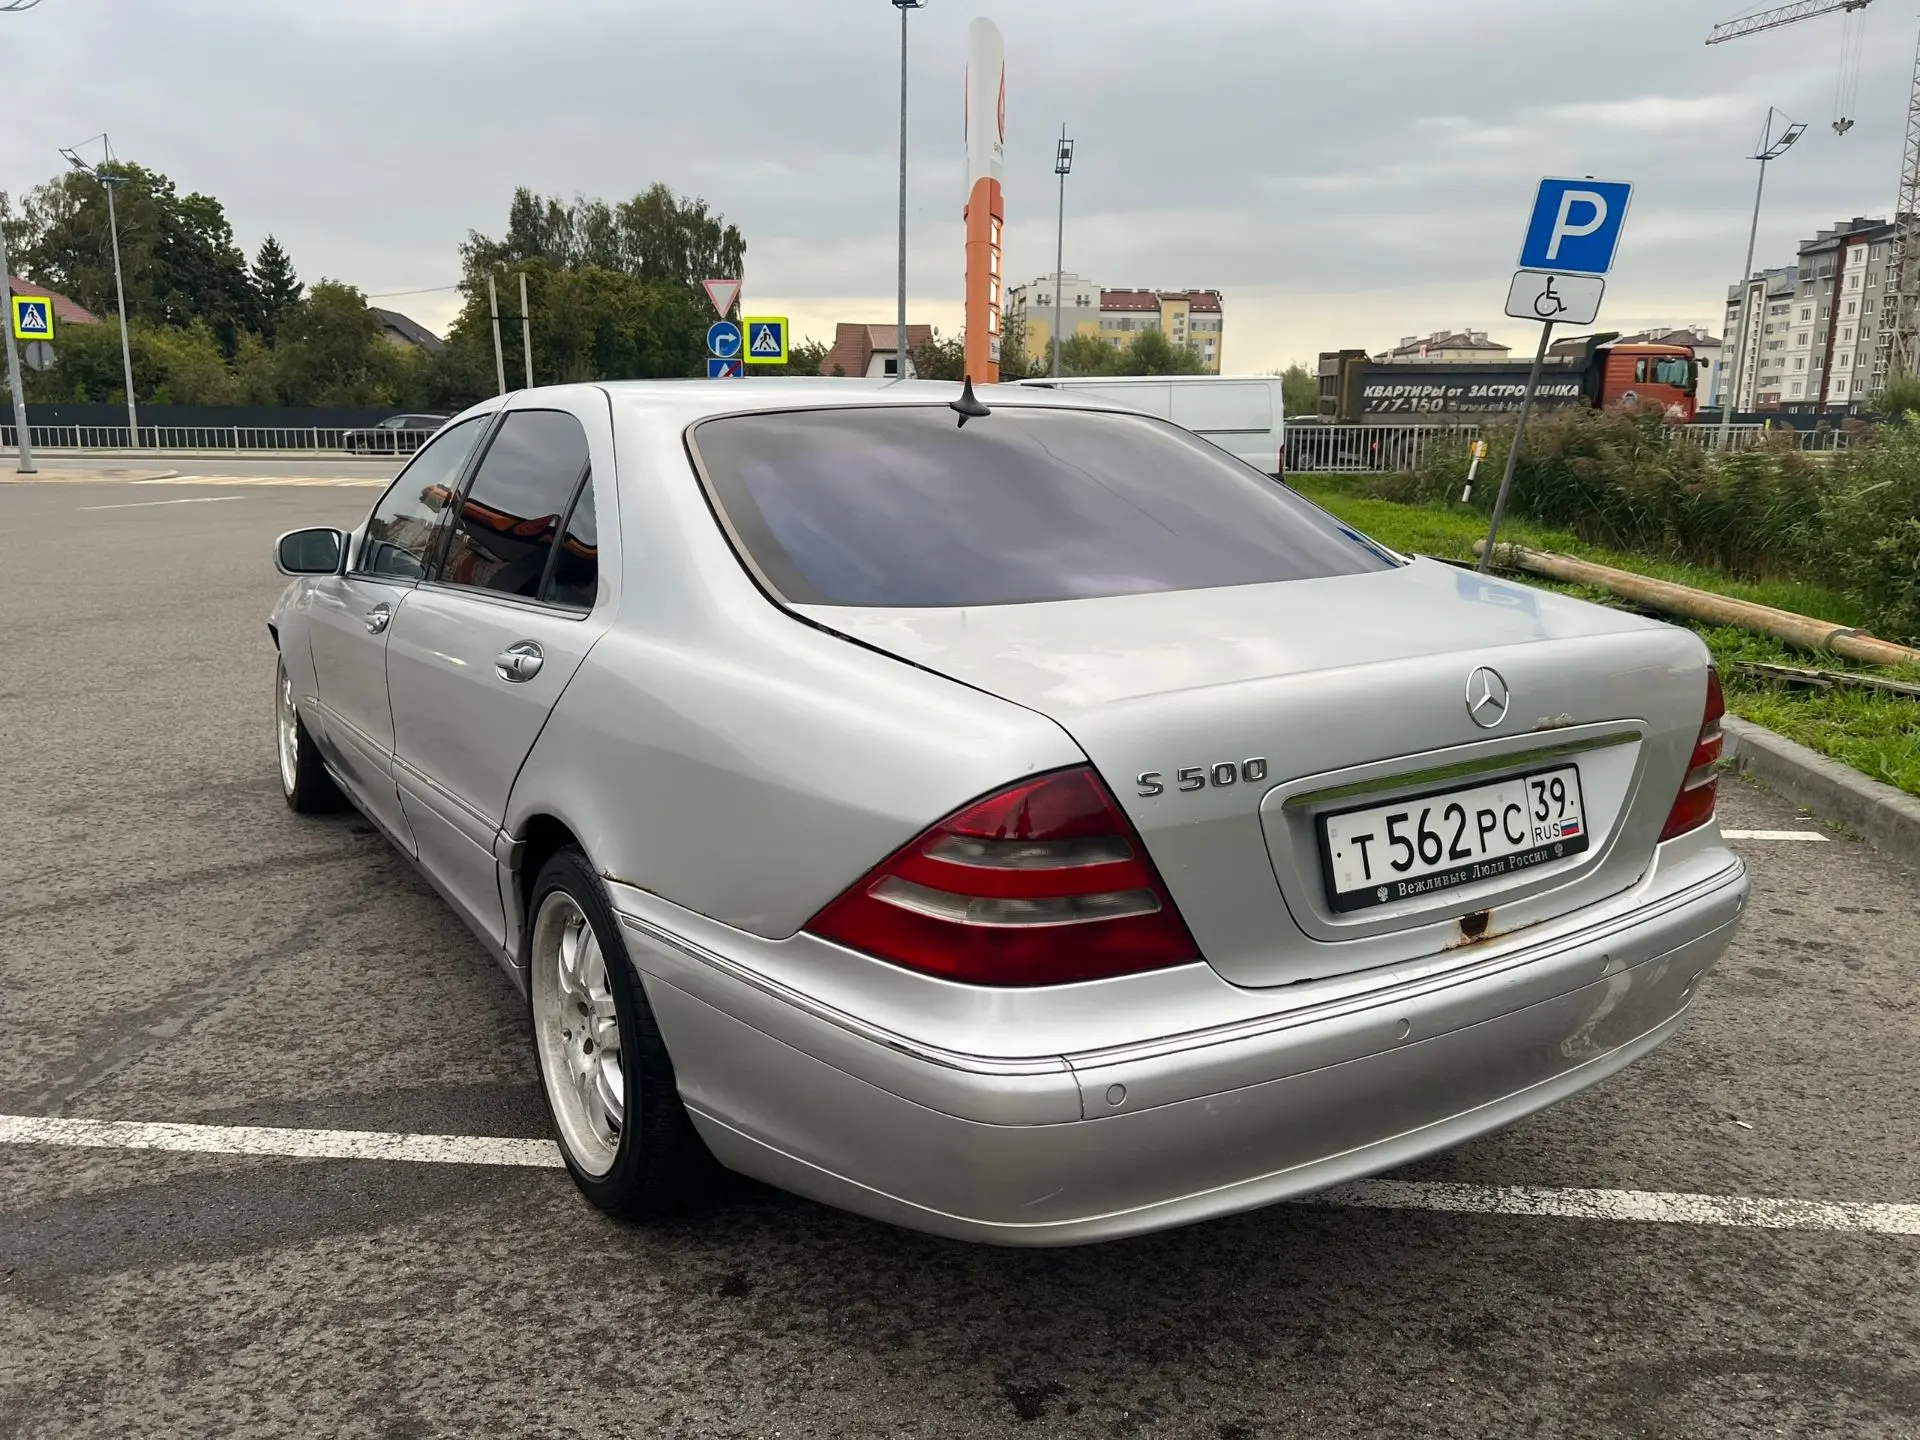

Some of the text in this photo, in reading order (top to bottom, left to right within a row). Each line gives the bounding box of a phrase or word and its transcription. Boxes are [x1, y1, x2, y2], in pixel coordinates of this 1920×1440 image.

[1546, 190, 1607, 260] P
[1363, 384, 1579, 398] КВАРТИРЫ от ЗАСТРОЩИКА
[1137, 757, 1267, 797] S 500
[1351, 777, 1565, 880] Т562РС 39
[1535, 822, 1560, 842] RUS
[1398, 850, 1548, 896] Вежливые Люди России
